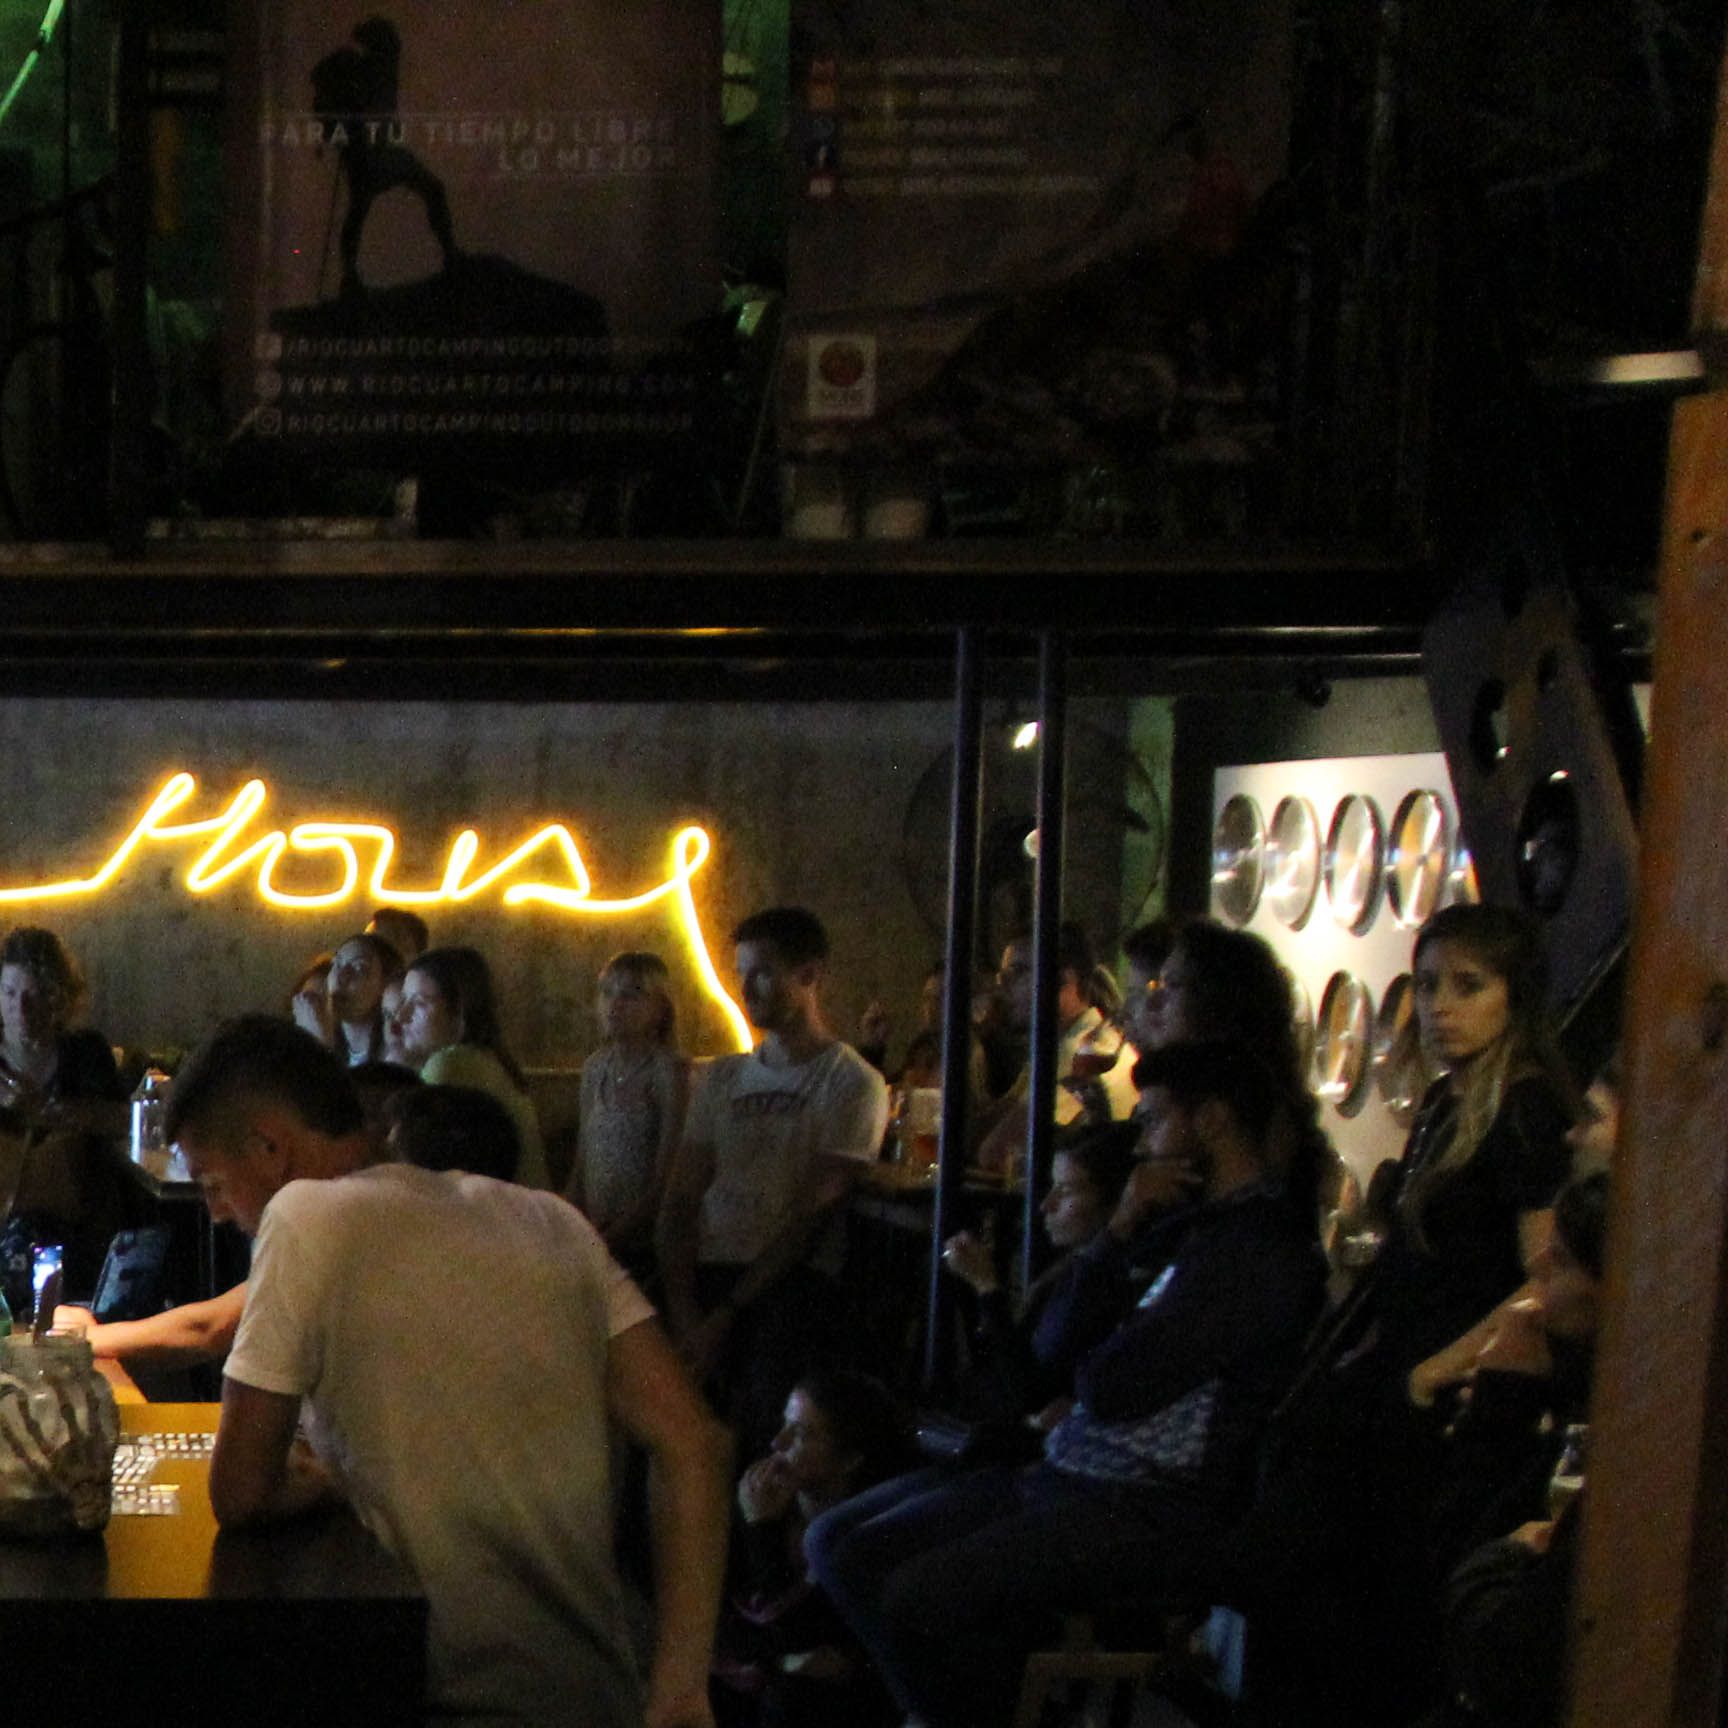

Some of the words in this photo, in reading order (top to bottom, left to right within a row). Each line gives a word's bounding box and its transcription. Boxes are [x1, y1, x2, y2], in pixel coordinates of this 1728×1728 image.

[258, 121, 350, 145] PARA
[365, 120, 407, 145] TU
[423, 119, 556, 145] TIEMPO
[572, 117, 676, 144] LIBRE
[497, 147, 540, 171] LO
[556, 144, 676, 170] MEJOR
